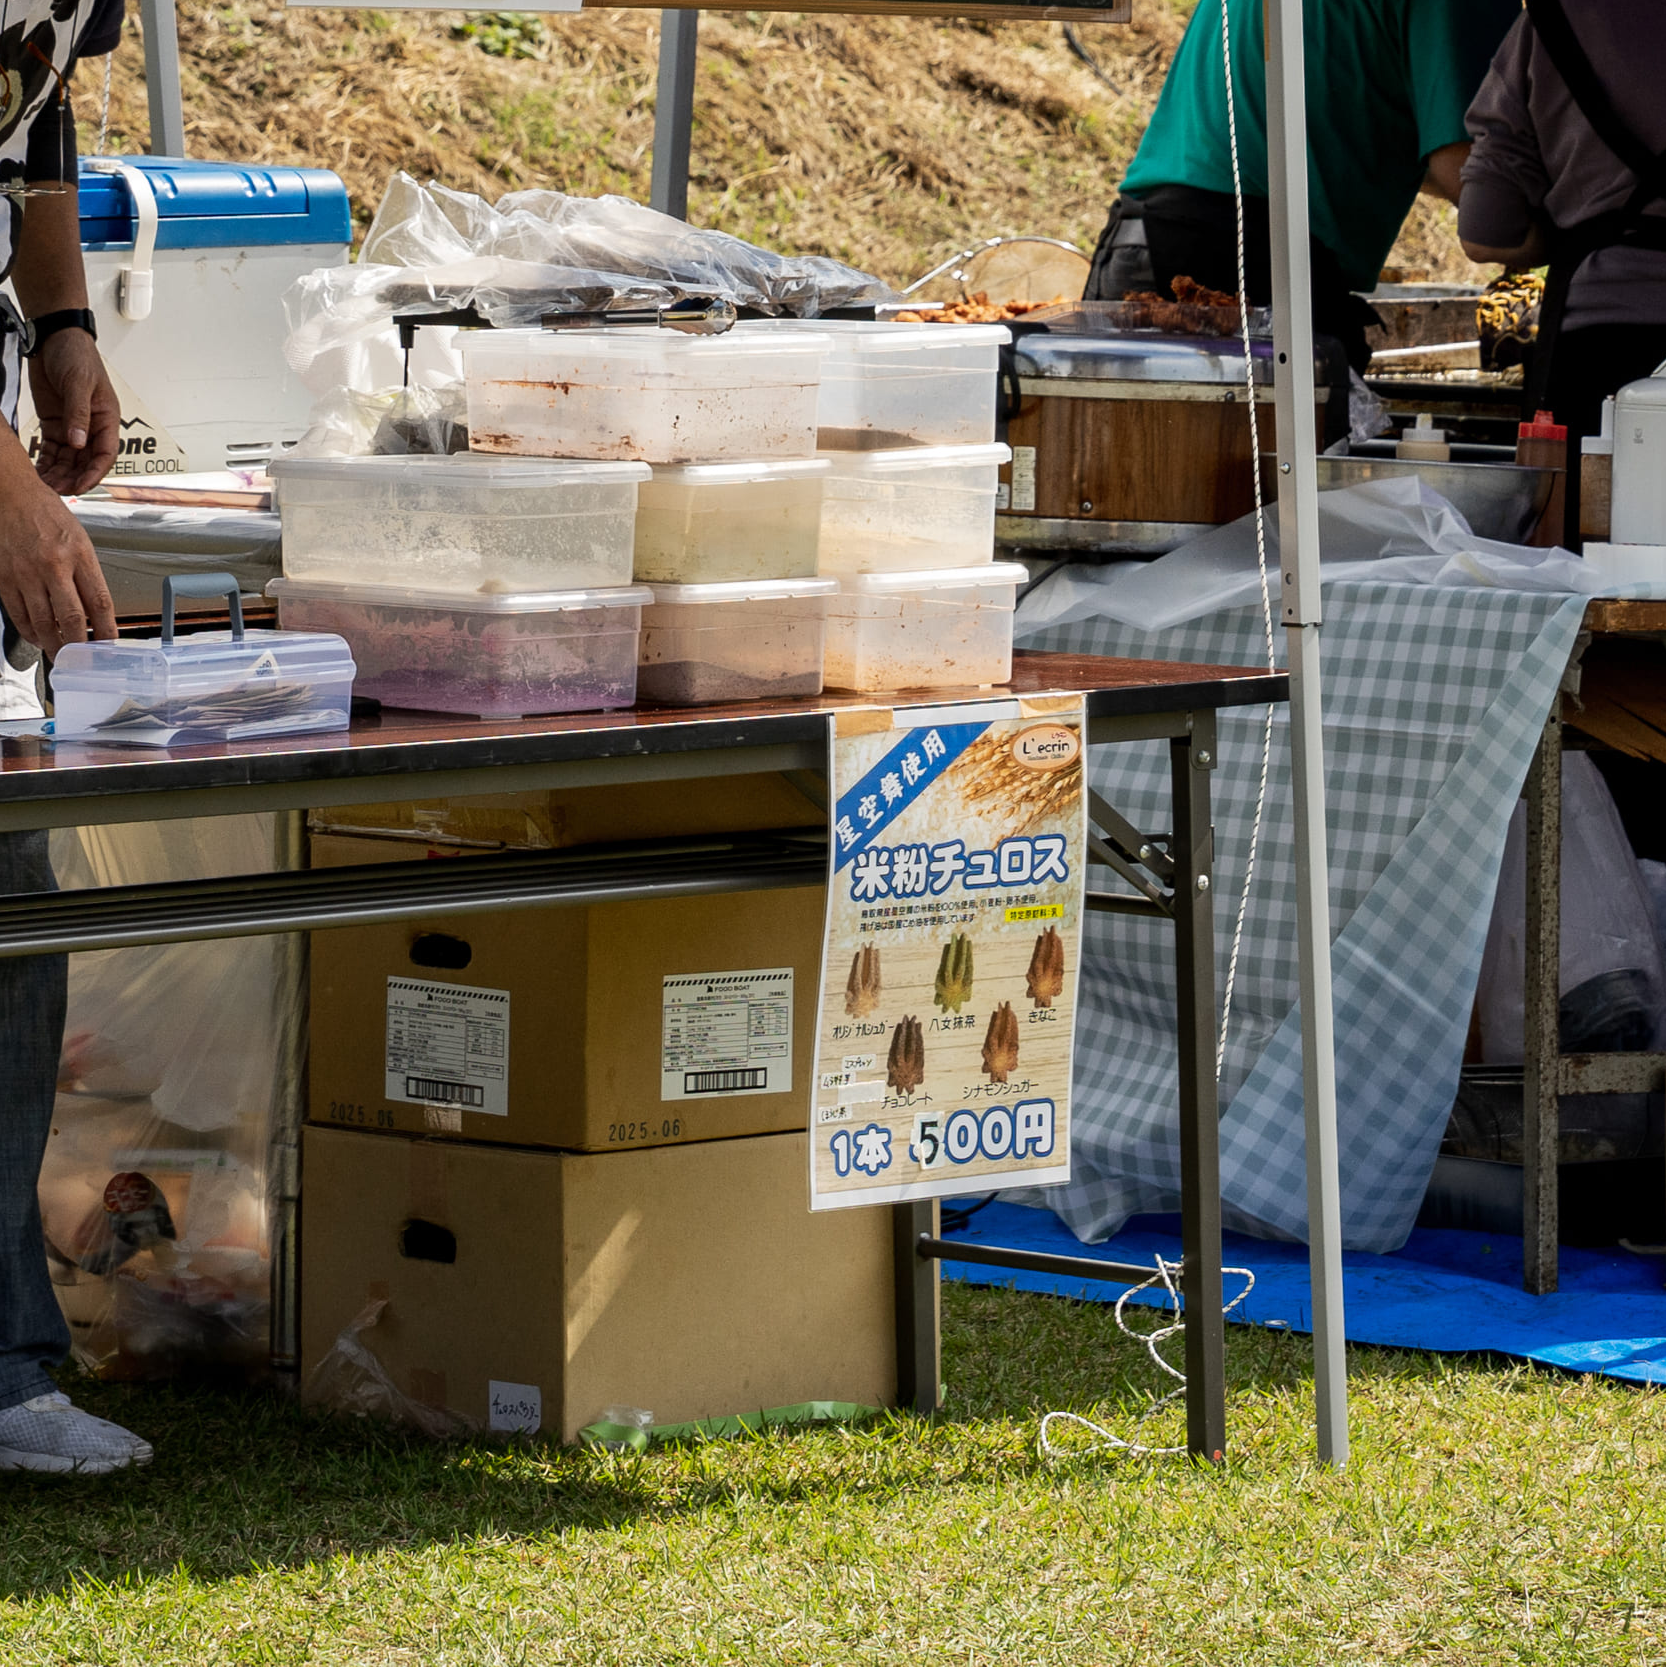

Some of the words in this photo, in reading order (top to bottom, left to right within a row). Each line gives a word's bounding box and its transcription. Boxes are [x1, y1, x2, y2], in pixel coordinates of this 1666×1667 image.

[145, 459, 185, 472] COOL
[835, 728, 946, 852] 星空舞使用
[852, 836, 1068, 900] 米粉チュロス
[929, 1015, 976, 1031] 八女抹茶
[1028, 1008, 1058, 1023] きなこ
[881, 1092, 933, 1109] チョコレート
[963, 1080, 1039, 1100] シナモンシュガー
[330, 1102, 394, 1128] 2025.06
[609, 1119, 680, 1142] 2025.06
[831, 1126, 892, 1176] 1本
[918, 1100, 1054, 1168] 500円
